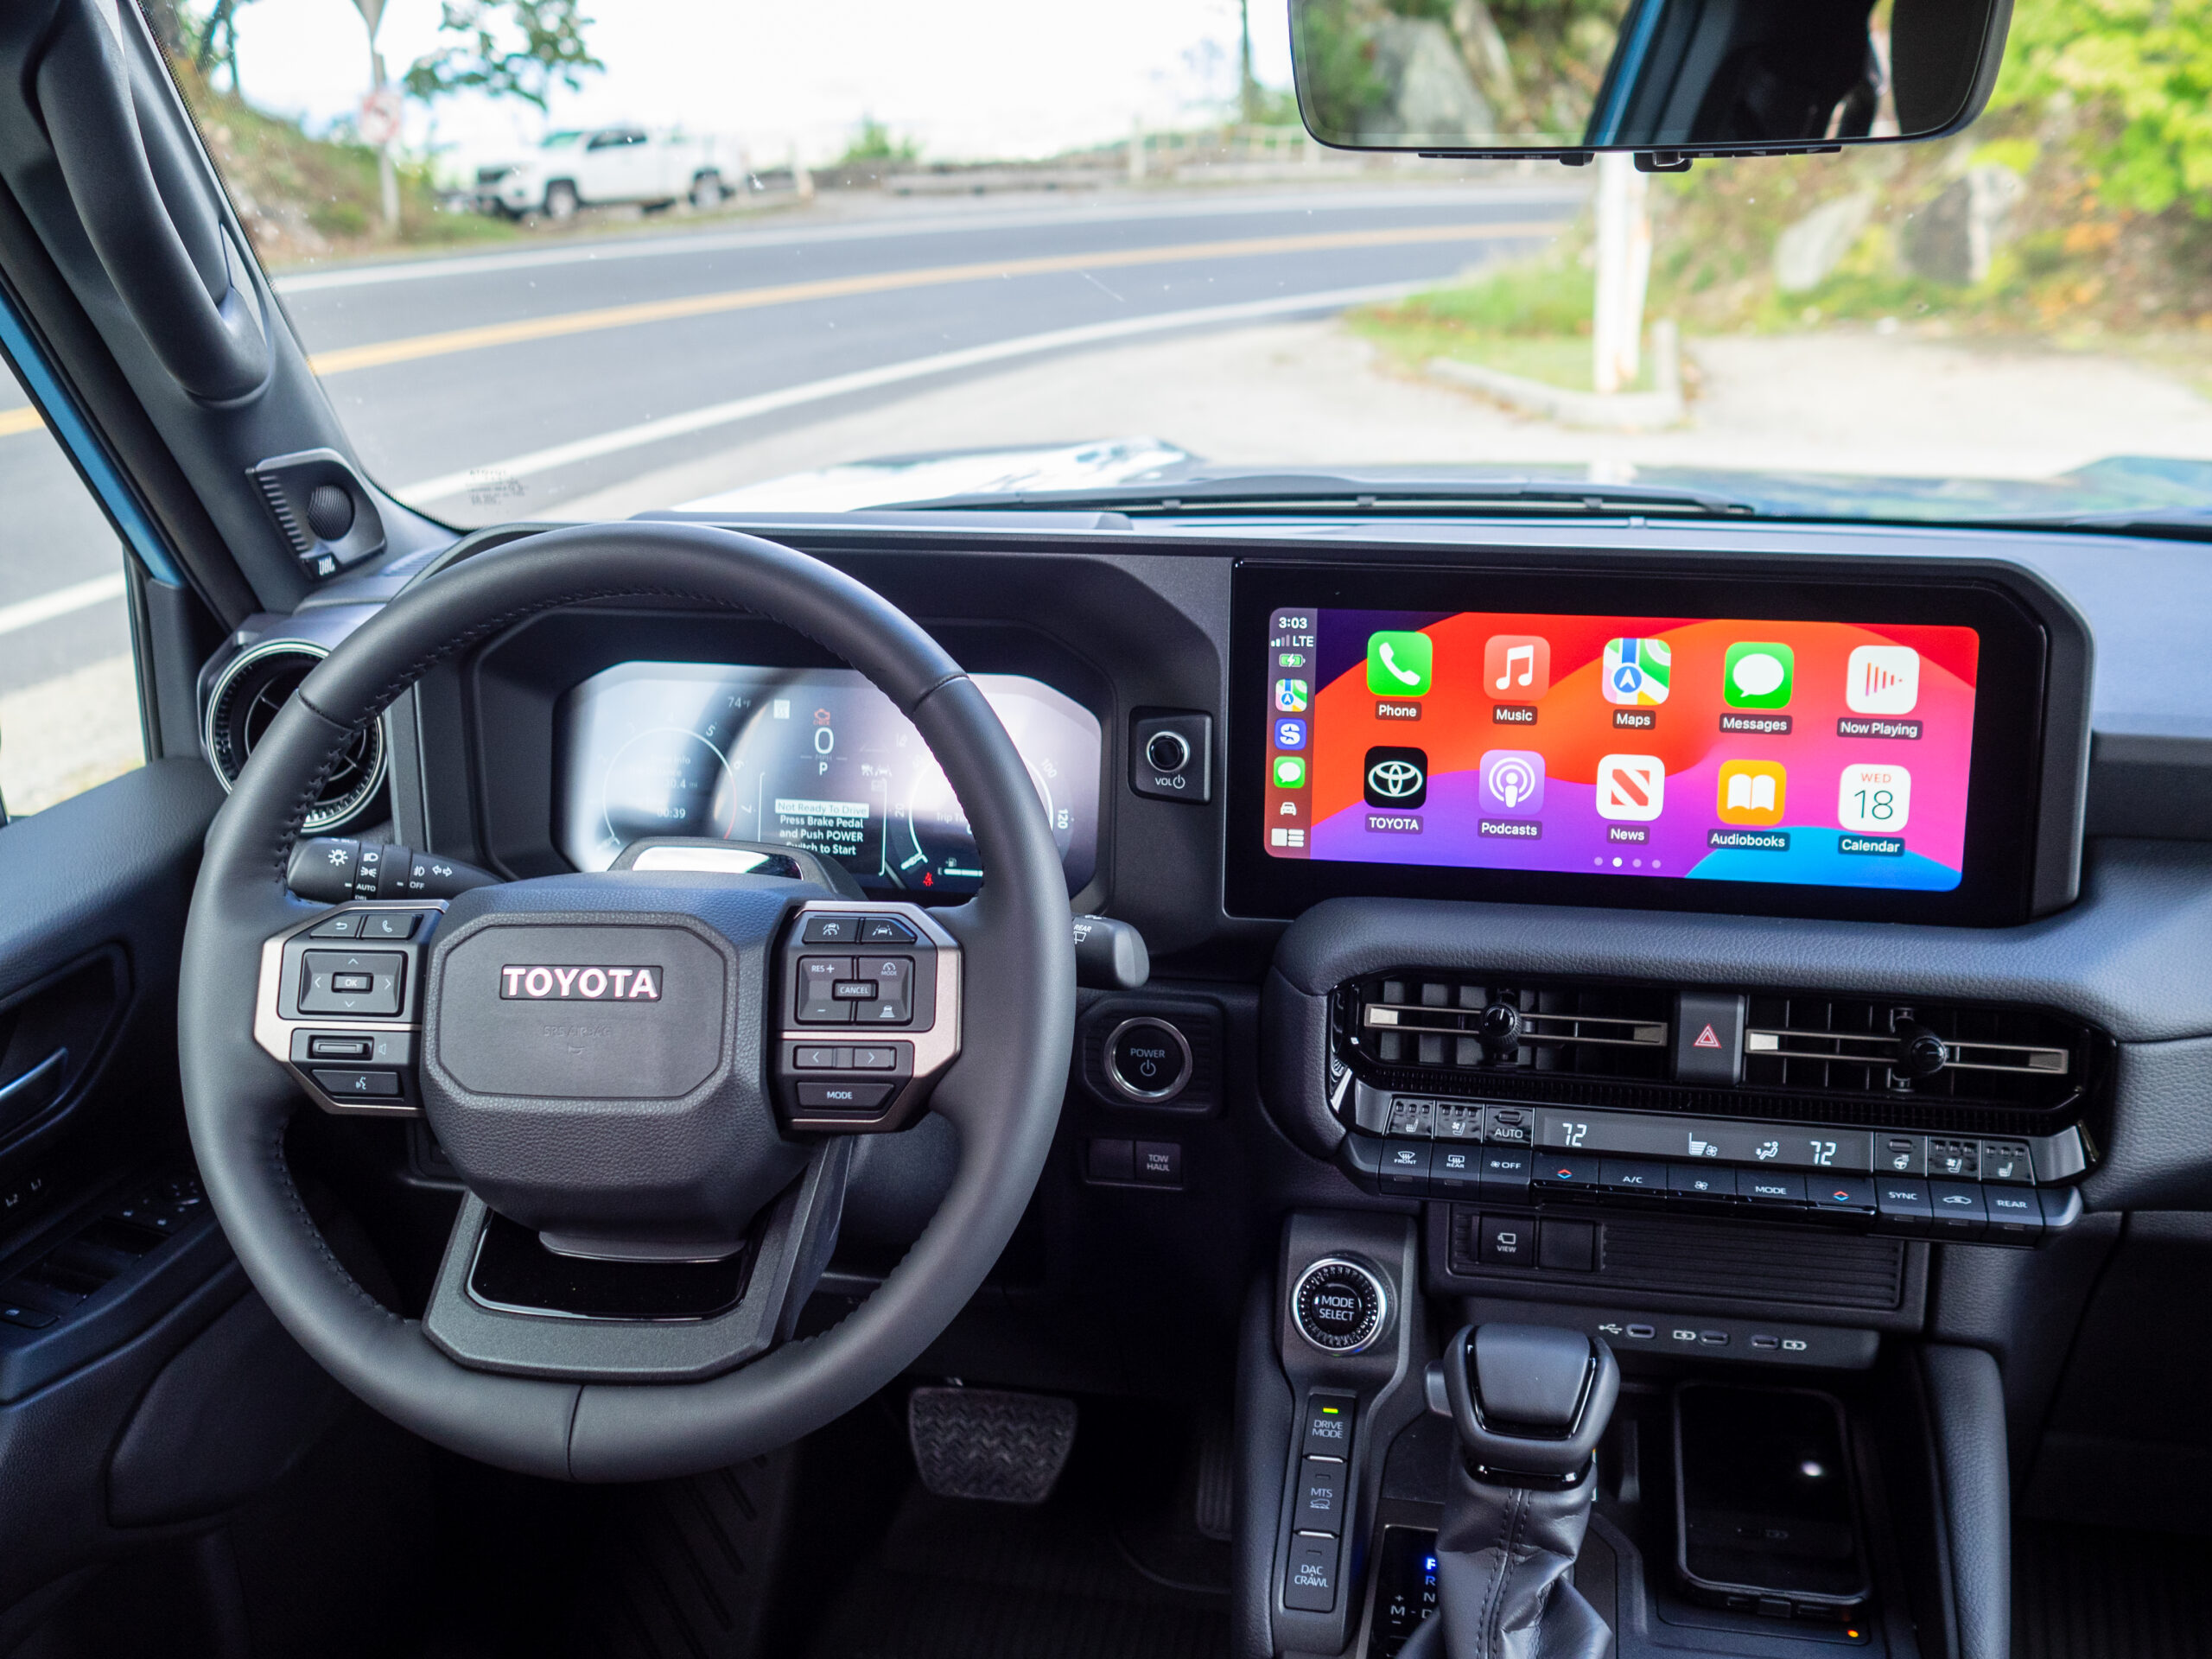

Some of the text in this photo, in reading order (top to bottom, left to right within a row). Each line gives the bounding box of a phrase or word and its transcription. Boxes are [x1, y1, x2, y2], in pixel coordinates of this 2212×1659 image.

[1279, 616, 1307, 629] 3:03
[1293, 635, 1314, 647] LTE
[1378, 704, 1417, 718] Phone
[1496, 709, 1533, 721] Music
[1616, 713, 1651, 727] Maps
[1722, 717, 1788, 733] Messages
[1840, 721, 1918, 738] Now Playing
[814, 727, 834, 754] 0
[819, 761, 829, 776] P
[1155, 777, 1173, 786] VOL
[1860, 772, 1892, 784] WED
[778, 802, 867, 816] Not Ready To Drive
[1854, 790, 1894, 820] 18
[779, 815, 864, 830] Press Brake Pedal
[1057, 809, 1069, 830] 120
[1369, 817, 1419, 830] TOYOTA
[779, 829, 864, 842] and Push POWER
[1481, 823, 1538, 836] Podcasts
[1610, 828, 1645, 842] News
[1710, 832, 1786, 849] Audiobooks
[1841, 838, 1901, 854] Calendar
[820, 843, 830, 854] to
[832, 843, 857, 855] Start
[356, 883, 377, 893] AUTO
[410, 881, 425, 890] OFF
[1073, 924, 1092, 932] REAR
[345, 978, 358, 987] OK
[502, 967, 658, 998] TOYOTA
[839, 986, 869, 995] CANCEL
[1130, 1047, 1166, 1058] POWER
[826, 1091, 853, 1100] MODE
[1494, 1128, 1523, 1139] AUTO
[1562, 1122, 1587, 1147] 72
[1147, 1153, 1169, 1164] TOW
[1809, 1140, 1837, 1166] 72
[1146, 1162, 1170, 1173] HAUL
[1755, 1185, 1788, 1195] MODE
[1888, 1192, 1918, 1201] SYNC
[1996, 1199, 2028, 1209] REAR
[1321, 1294, 1355, 1309] MODE
[1319, 1308, 1355, 1321] SELECT
[1313, 1419, 1344, 1430] DRIVE
[1312, 1428, 1344, 1439] MODE
[1310, 1487, 1332, 1498] MTS
[1300, 1564, 1324, 1575] DAC
[1294, 1574, 1330, 1588] CRAWL
[1423, 1592, 1435, 1603] N
[1390, 1605, 1406, 1617] M
